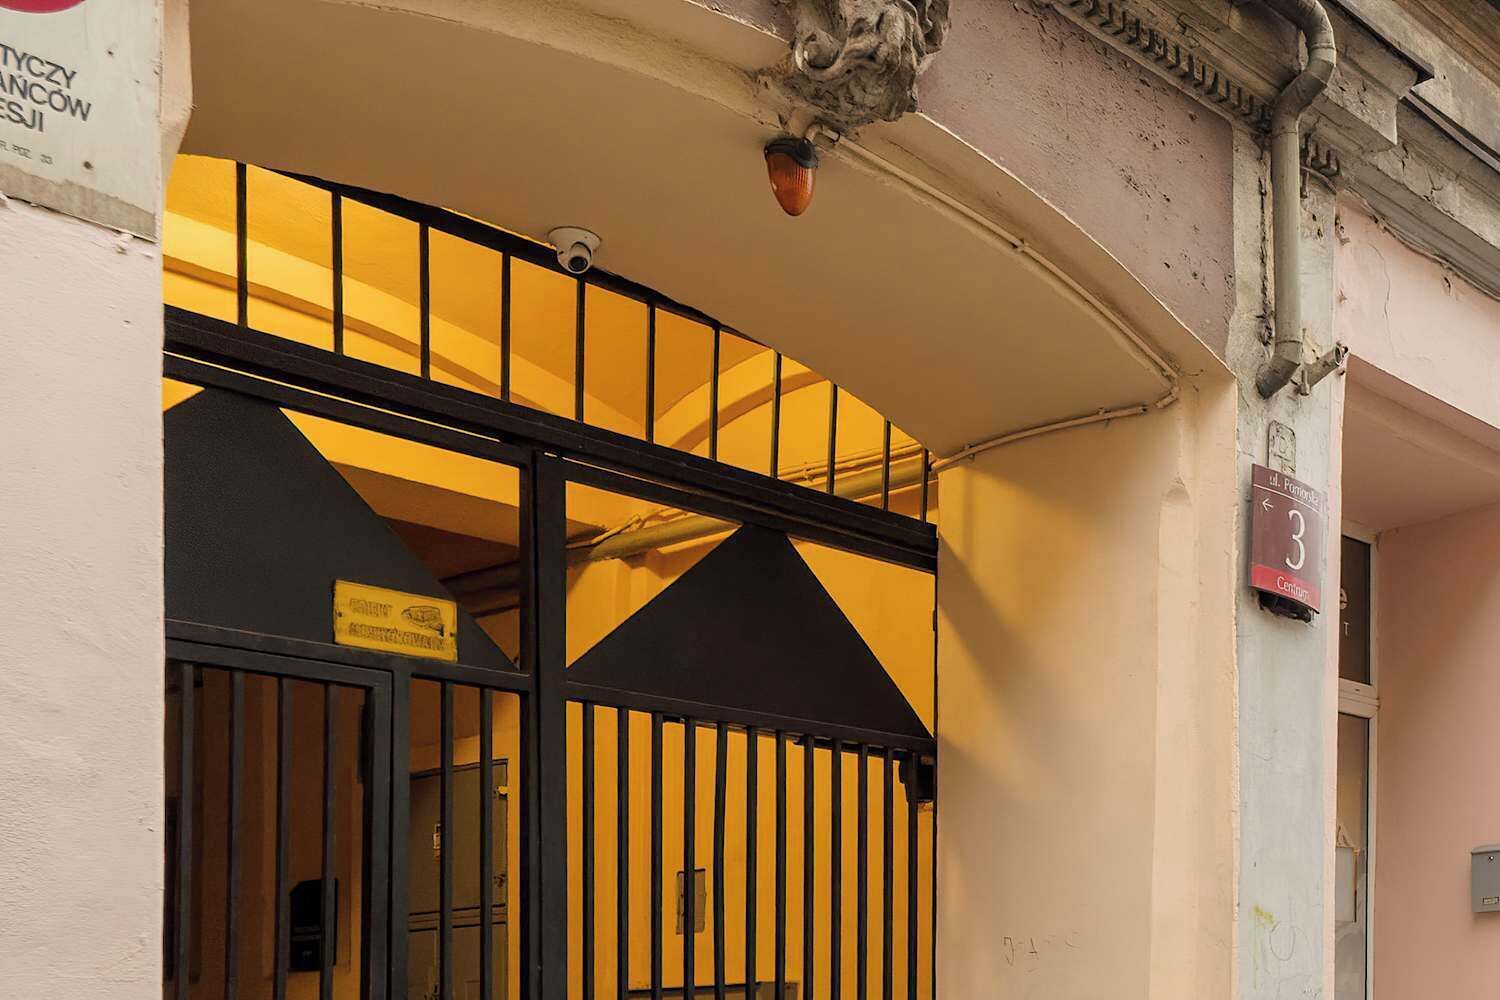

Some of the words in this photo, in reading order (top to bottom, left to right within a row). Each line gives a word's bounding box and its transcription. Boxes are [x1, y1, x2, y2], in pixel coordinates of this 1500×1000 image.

[1269, 472, 1281, 487] ul.
[1284, 478, 1319, 506] Pomorska
[1285, 509, 1305, 570] 3
[1276, 575, 1313, 602] Centrum
